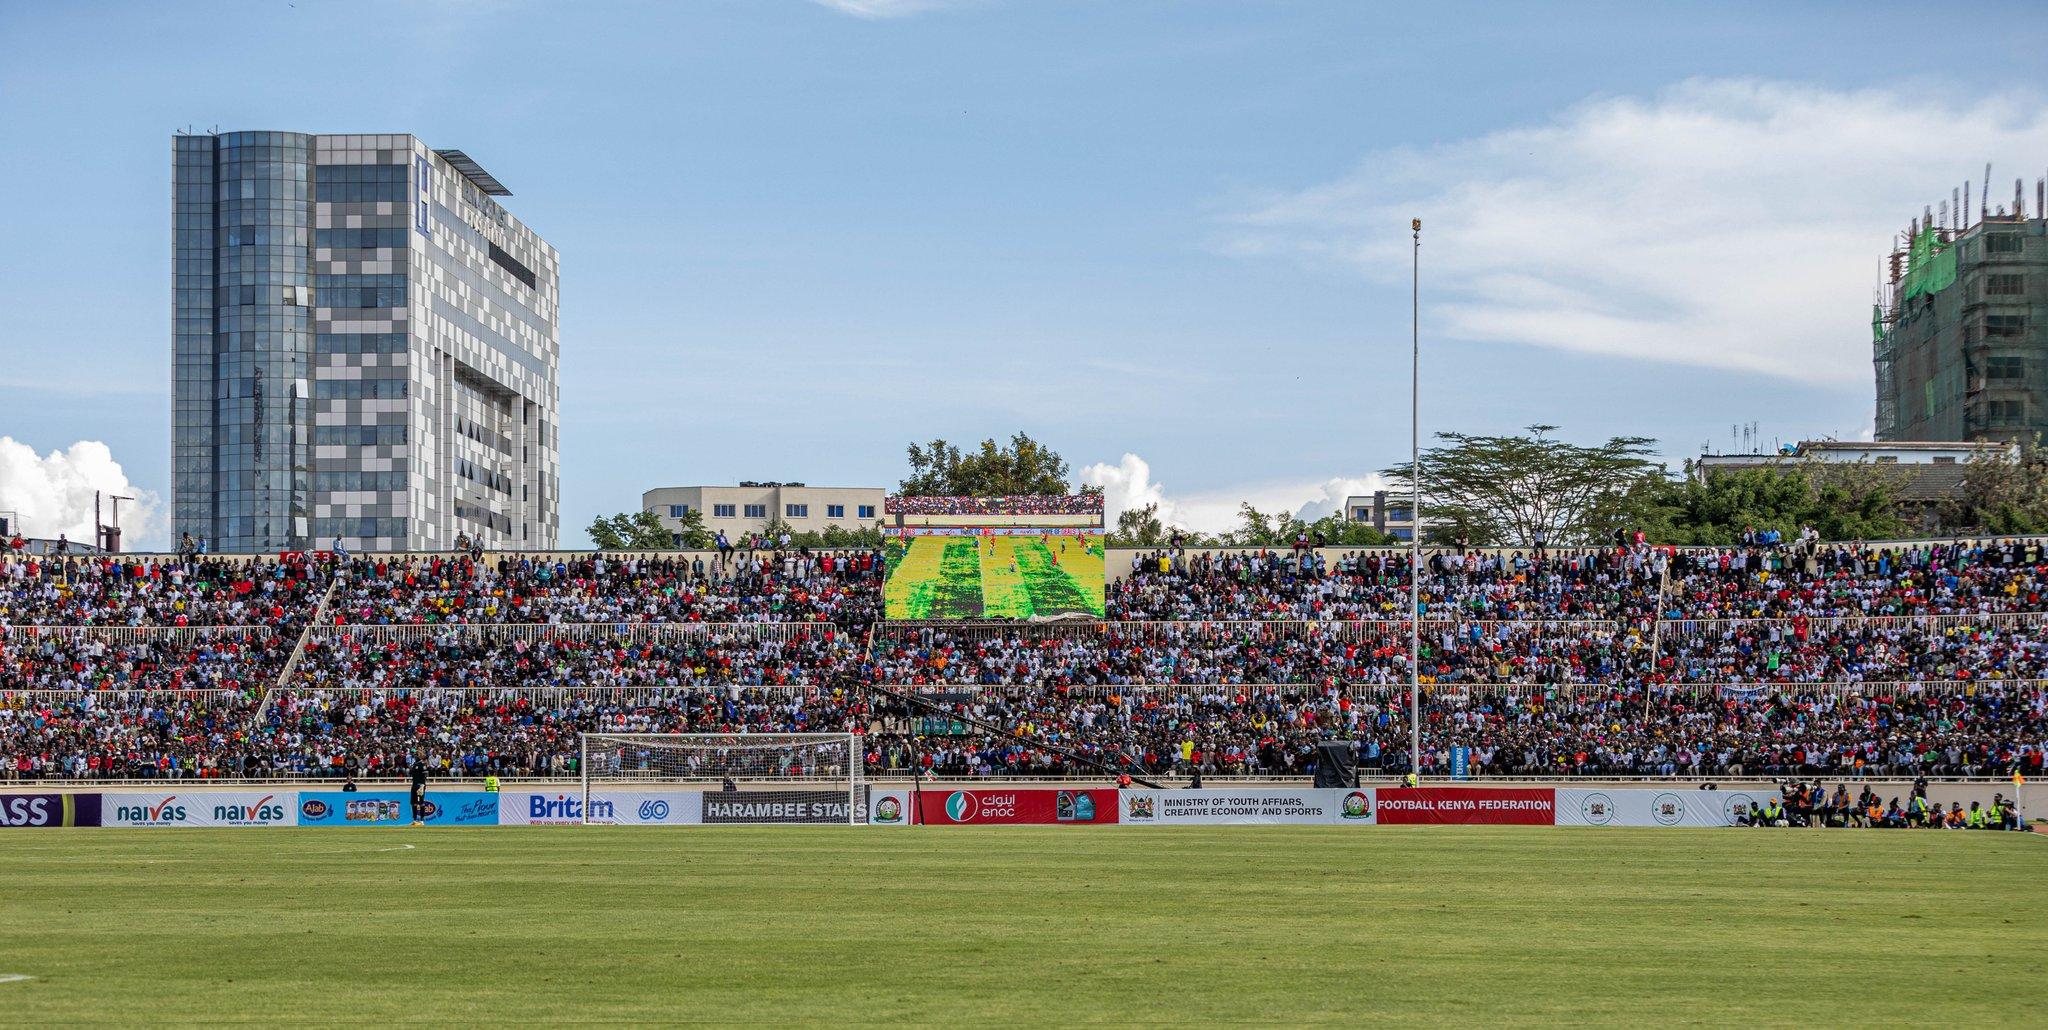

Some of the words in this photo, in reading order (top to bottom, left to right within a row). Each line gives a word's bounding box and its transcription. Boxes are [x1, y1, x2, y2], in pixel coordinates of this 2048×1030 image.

[286, 553, 319, 564] GAE
[322, 553, 330, 563] 3
[214, 794, 284, 821] naivas
[1164, 798, 1210, 807] MINISTRY
[1212, 798, 1226, 806] OF
[1227, 798, 1260, 806] YOUTH
[1377, 800, 1436, 810] FOOTBALL
[1437, 800, 1477, 810] KENYA
[1478, 800, 1551, 810] FEDERATION
[117, 795, 187, 822] naivas
[638, 800, 669, 820] 60
[707, 802, 807, 817] HARAMBEE
[981, 808, 1016, 817] enoc
[1164, 808, 1209, 817] CREATIVE
[1211, 807, 1260, 816] ECONOMY
[1261, 807, 1283, 816] AND
[1284, 807, 1323, 816] SPORTS
